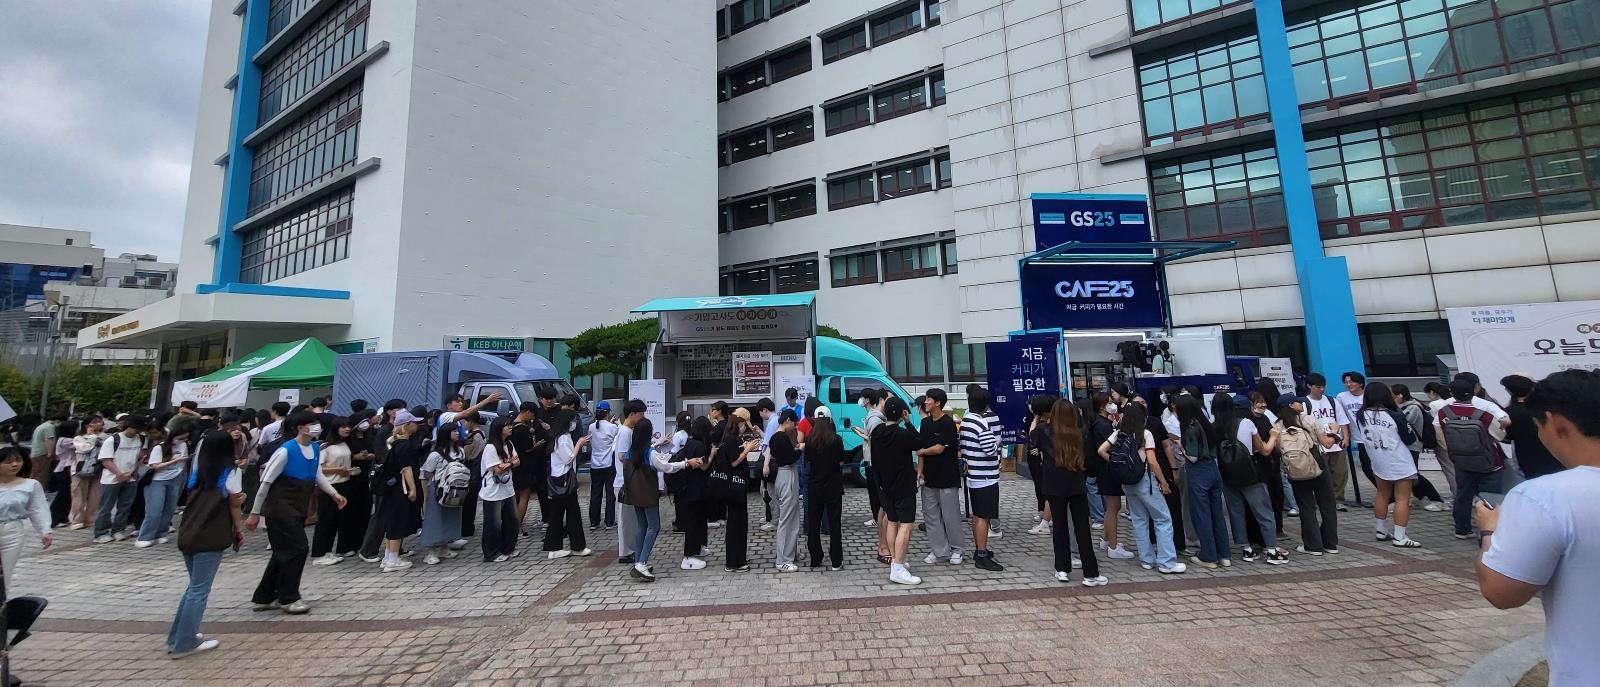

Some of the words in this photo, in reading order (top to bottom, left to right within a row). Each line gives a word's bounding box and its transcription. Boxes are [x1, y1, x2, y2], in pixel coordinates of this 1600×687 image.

[1070, 211, 1115, 227] GS25
[1055, 280, 1135, 298] CAFE25
[1066, 303, 1077, 311] 지금
[473, 341, 490, 349] KEB
[491, 340, 522, 349] 하나은행
[1021, 347, 1047, 361] 지금,
[1011, 362, 1045, 376] 커피가
[1012, 377, 1046, 392] 필요한
[1364, 417, 1393, 429] TUSSY
